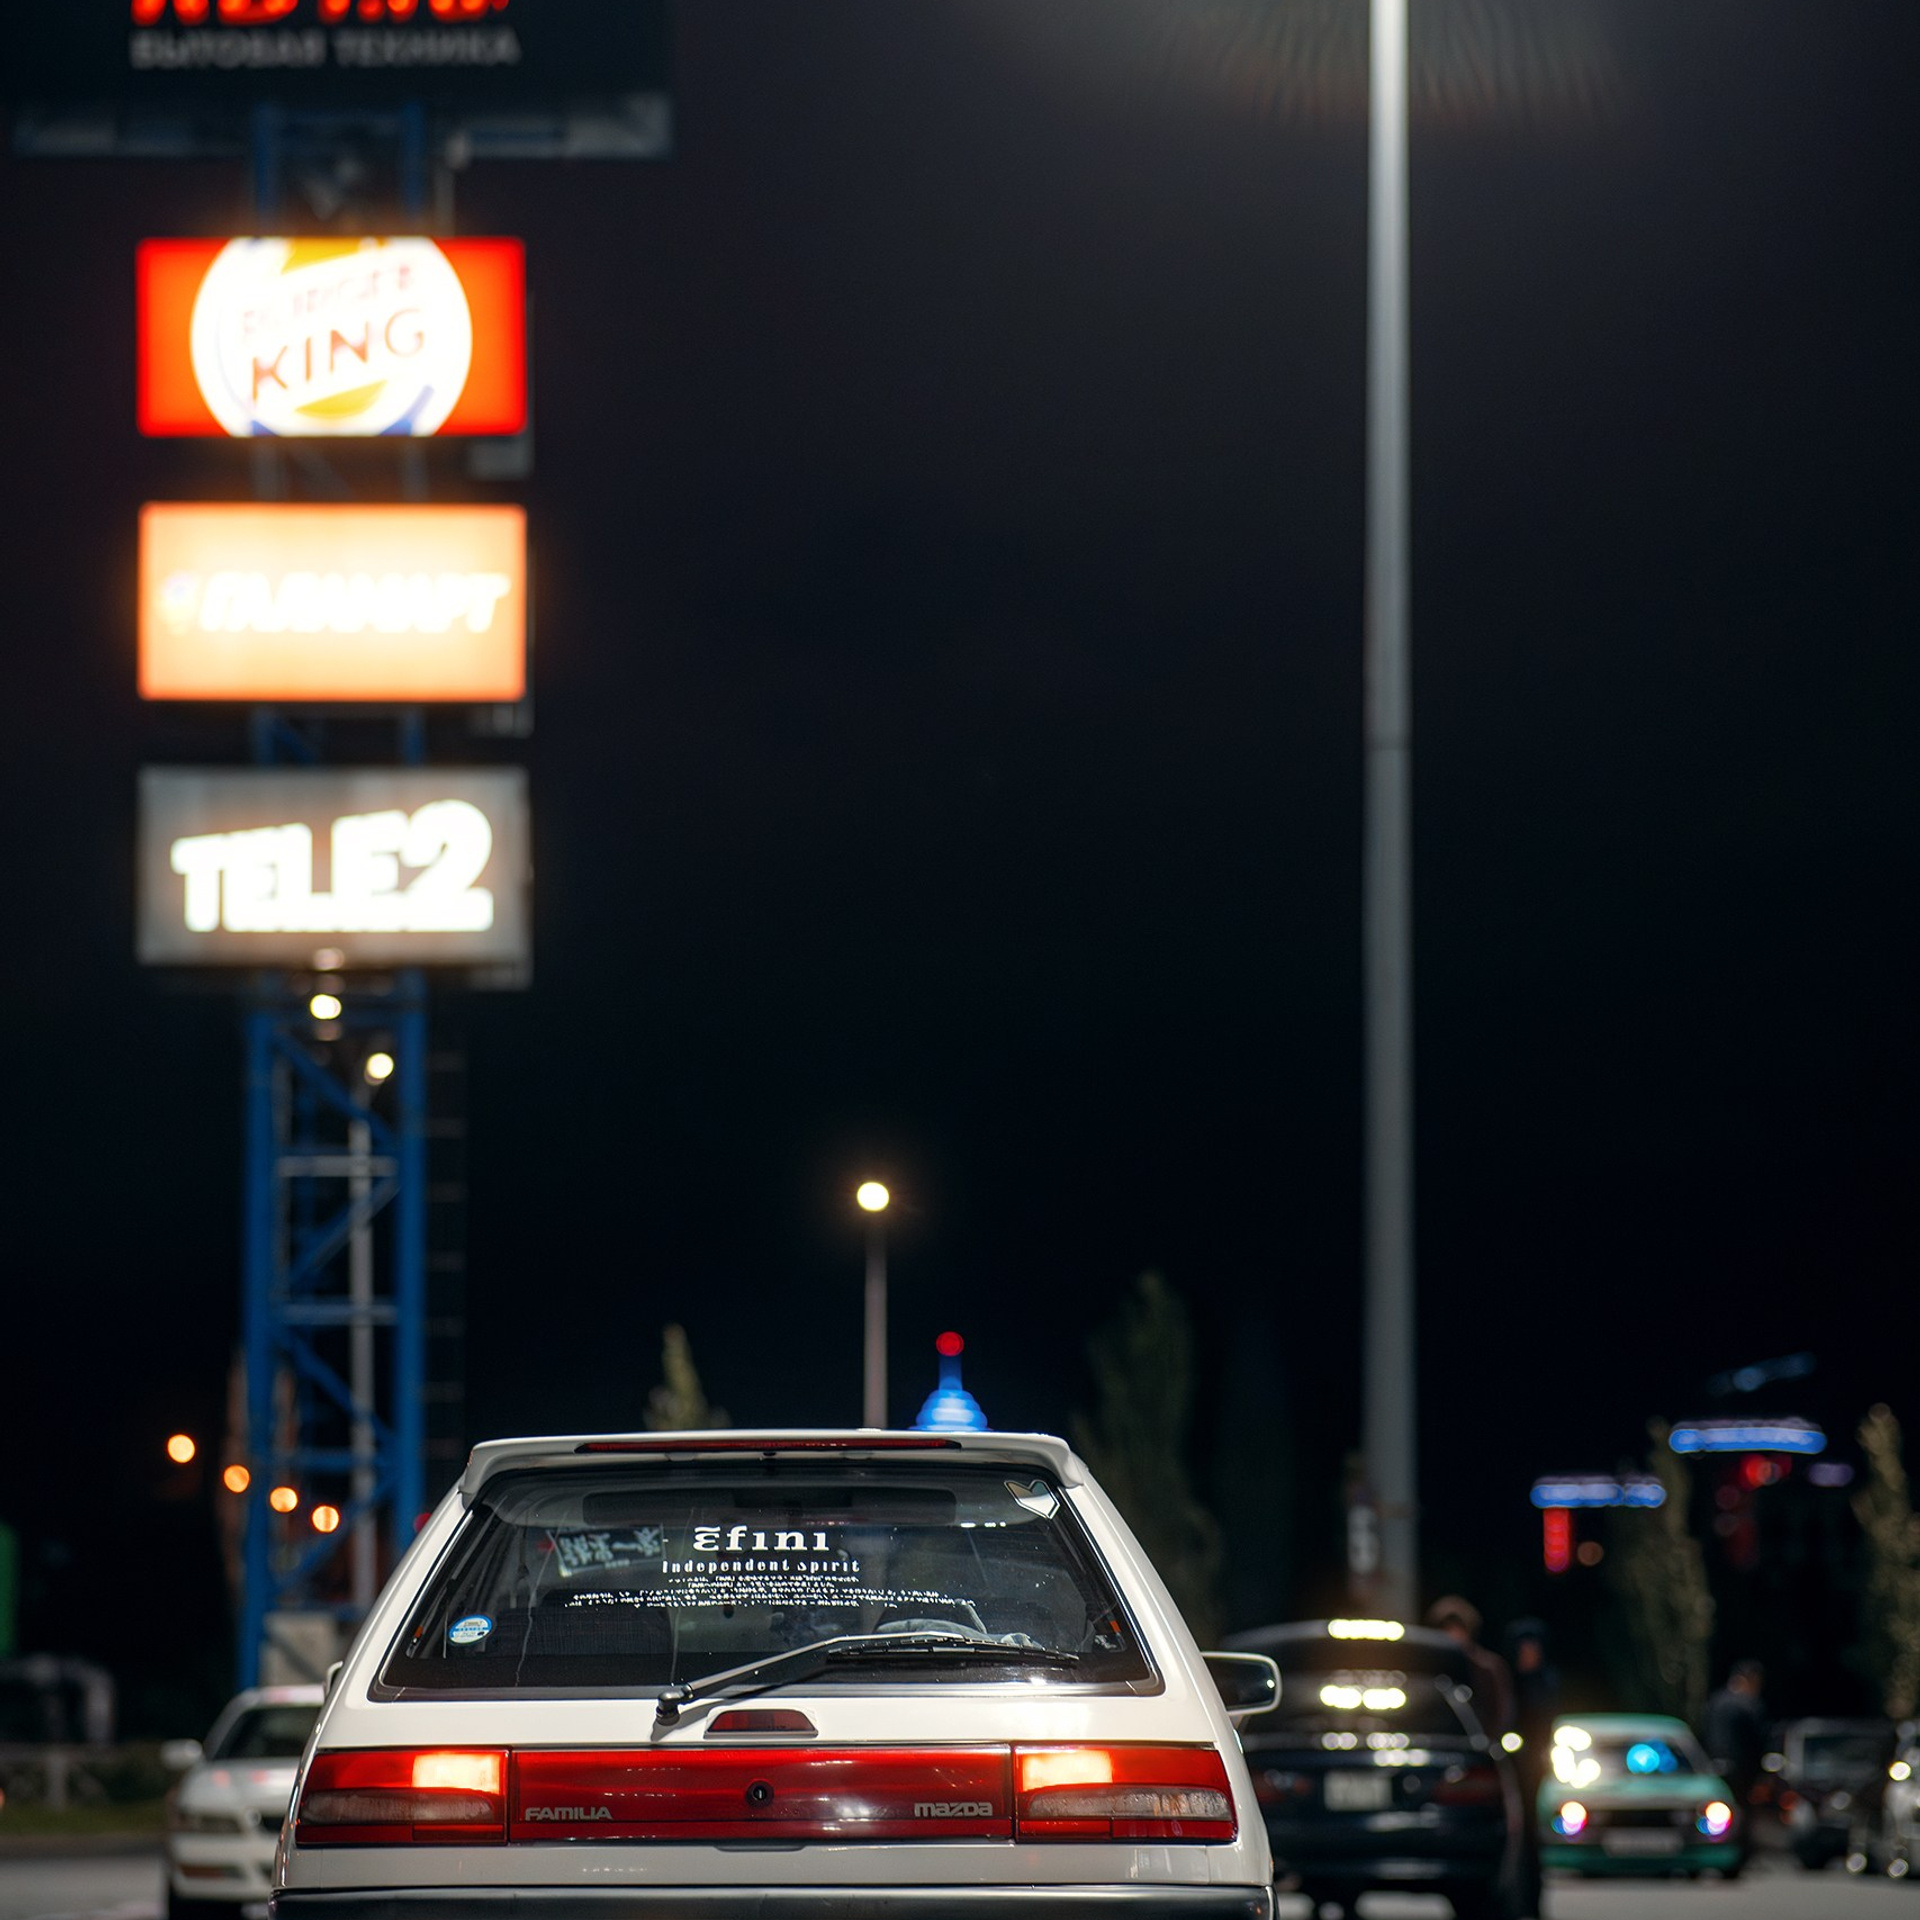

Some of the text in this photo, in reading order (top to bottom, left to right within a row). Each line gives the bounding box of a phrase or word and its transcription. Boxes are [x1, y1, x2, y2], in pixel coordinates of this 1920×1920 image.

[333, 28, 522, 67] ТЕХНИКА
[251, 307, 425, 402] KING
[171, 800, 493, 932] TELE2
[662, 1559, 860, 1574] Independent spirit
[525, 1806, 613, 1821] FAMILIA
